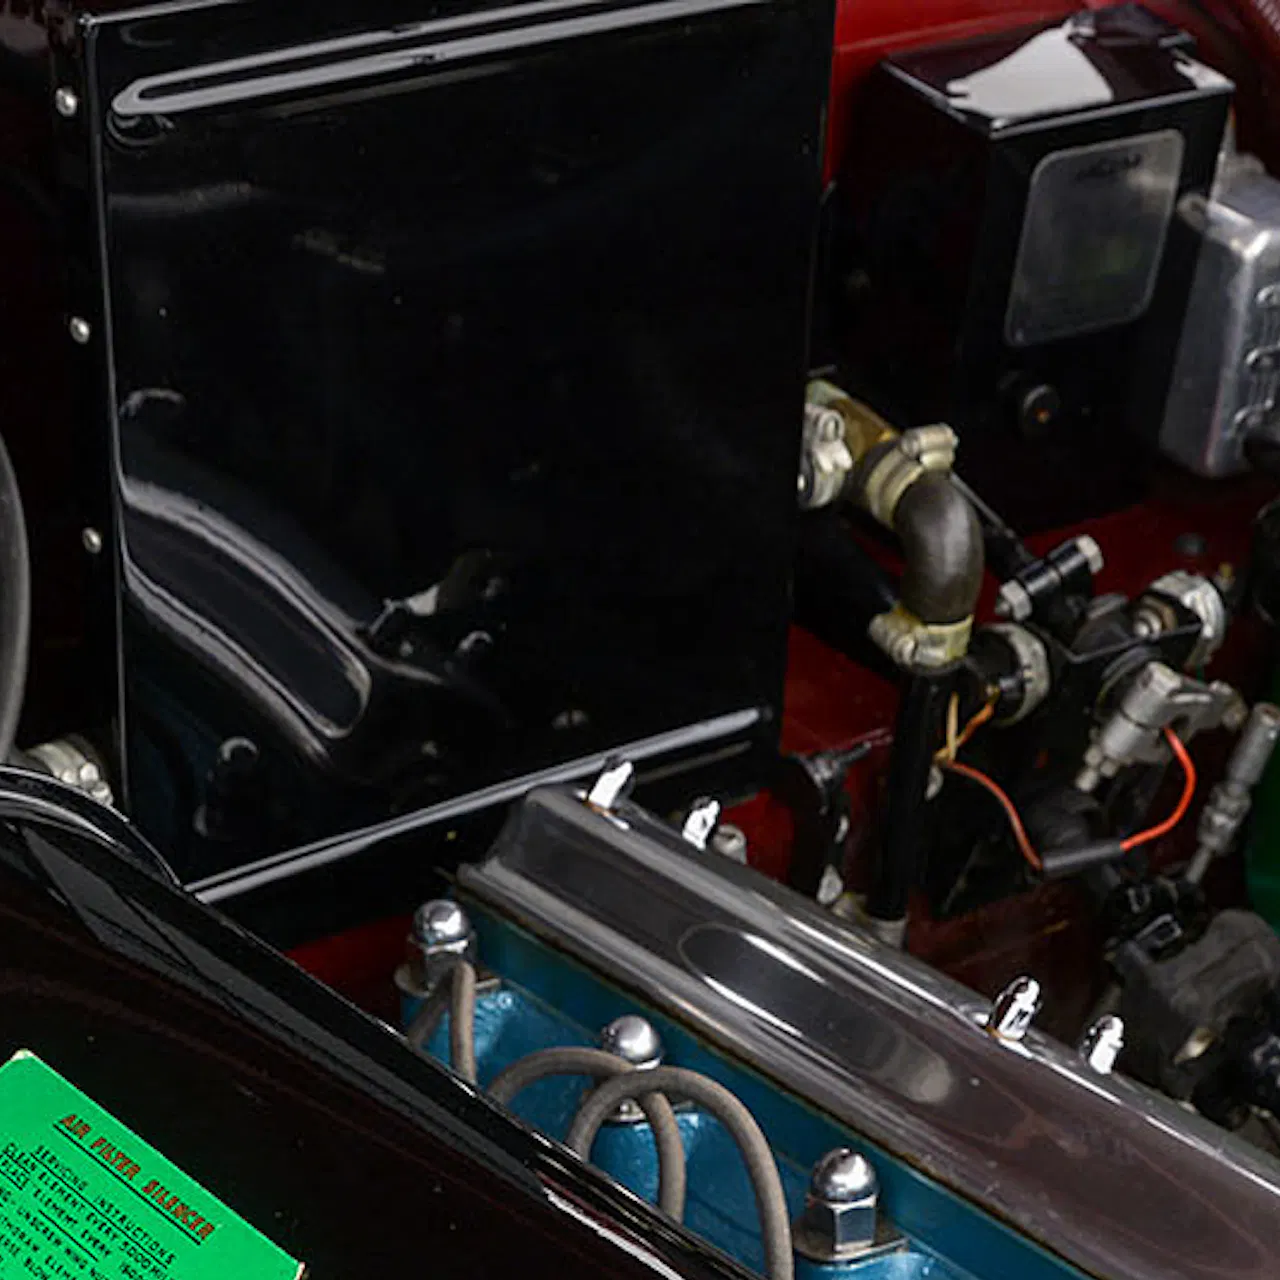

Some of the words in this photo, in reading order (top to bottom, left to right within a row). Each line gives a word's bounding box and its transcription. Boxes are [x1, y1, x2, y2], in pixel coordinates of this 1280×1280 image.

[2, 1142, 38, 1174] CLEAN
[33, 1144, 89, 1192] SERVICING
[92, 1194, 177, 1265] INSTRUCTIONS
[57, 1112, 93, 1140] AIR
[88, 1135, 143, 1180] FILTER
[140, 1178, 216, 1240] SILENCER
